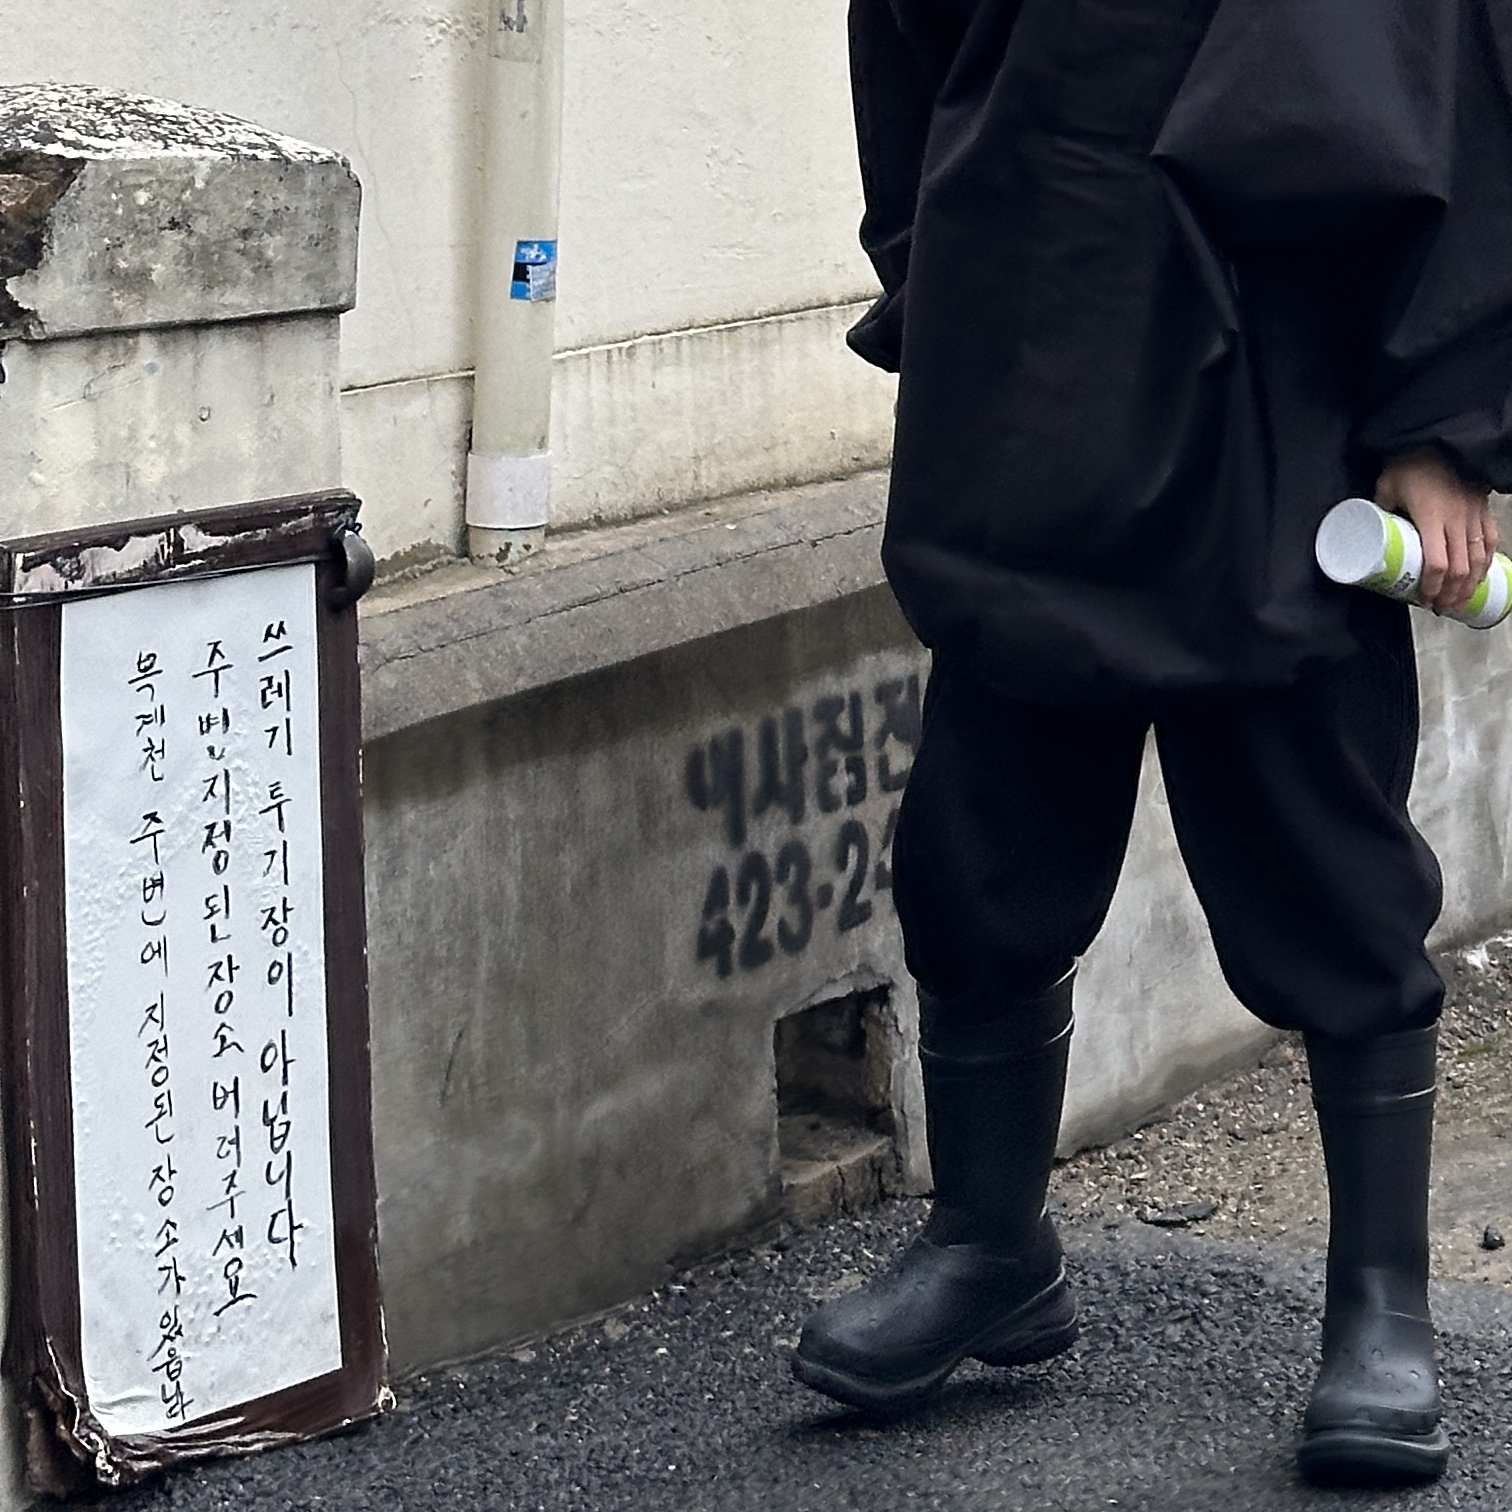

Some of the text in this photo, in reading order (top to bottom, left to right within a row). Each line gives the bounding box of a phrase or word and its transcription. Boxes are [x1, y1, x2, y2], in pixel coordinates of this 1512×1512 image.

[257, 620, 304, 1271] 쓰레기 투기장이 아닙니다
[137, 990, 176, 1145] 지정된
[148, 1152, 187, 1296] 장소가
